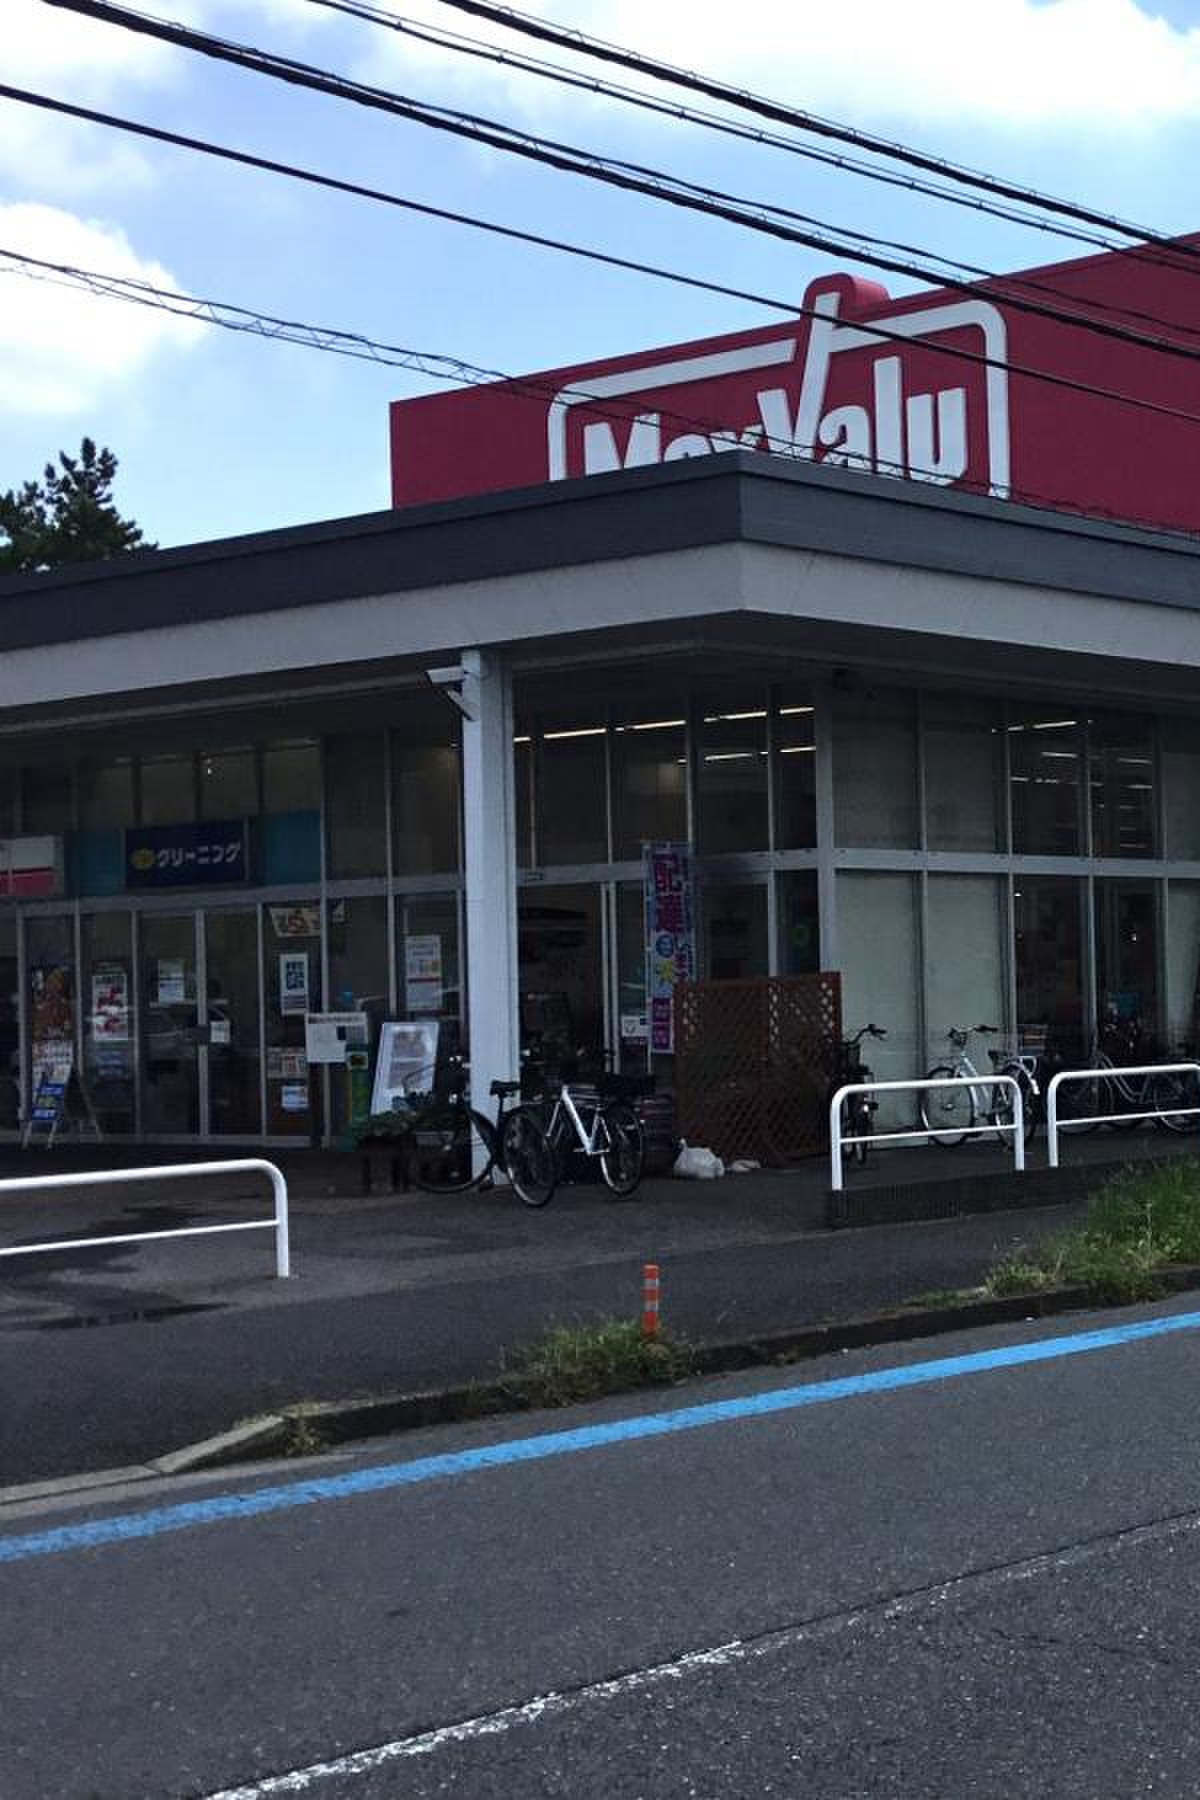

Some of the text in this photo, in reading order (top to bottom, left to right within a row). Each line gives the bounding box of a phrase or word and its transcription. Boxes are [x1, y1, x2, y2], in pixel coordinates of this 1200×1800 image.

[584, 292, 969, 486] Valu
[157, 841, 242, 868] クリーニング
